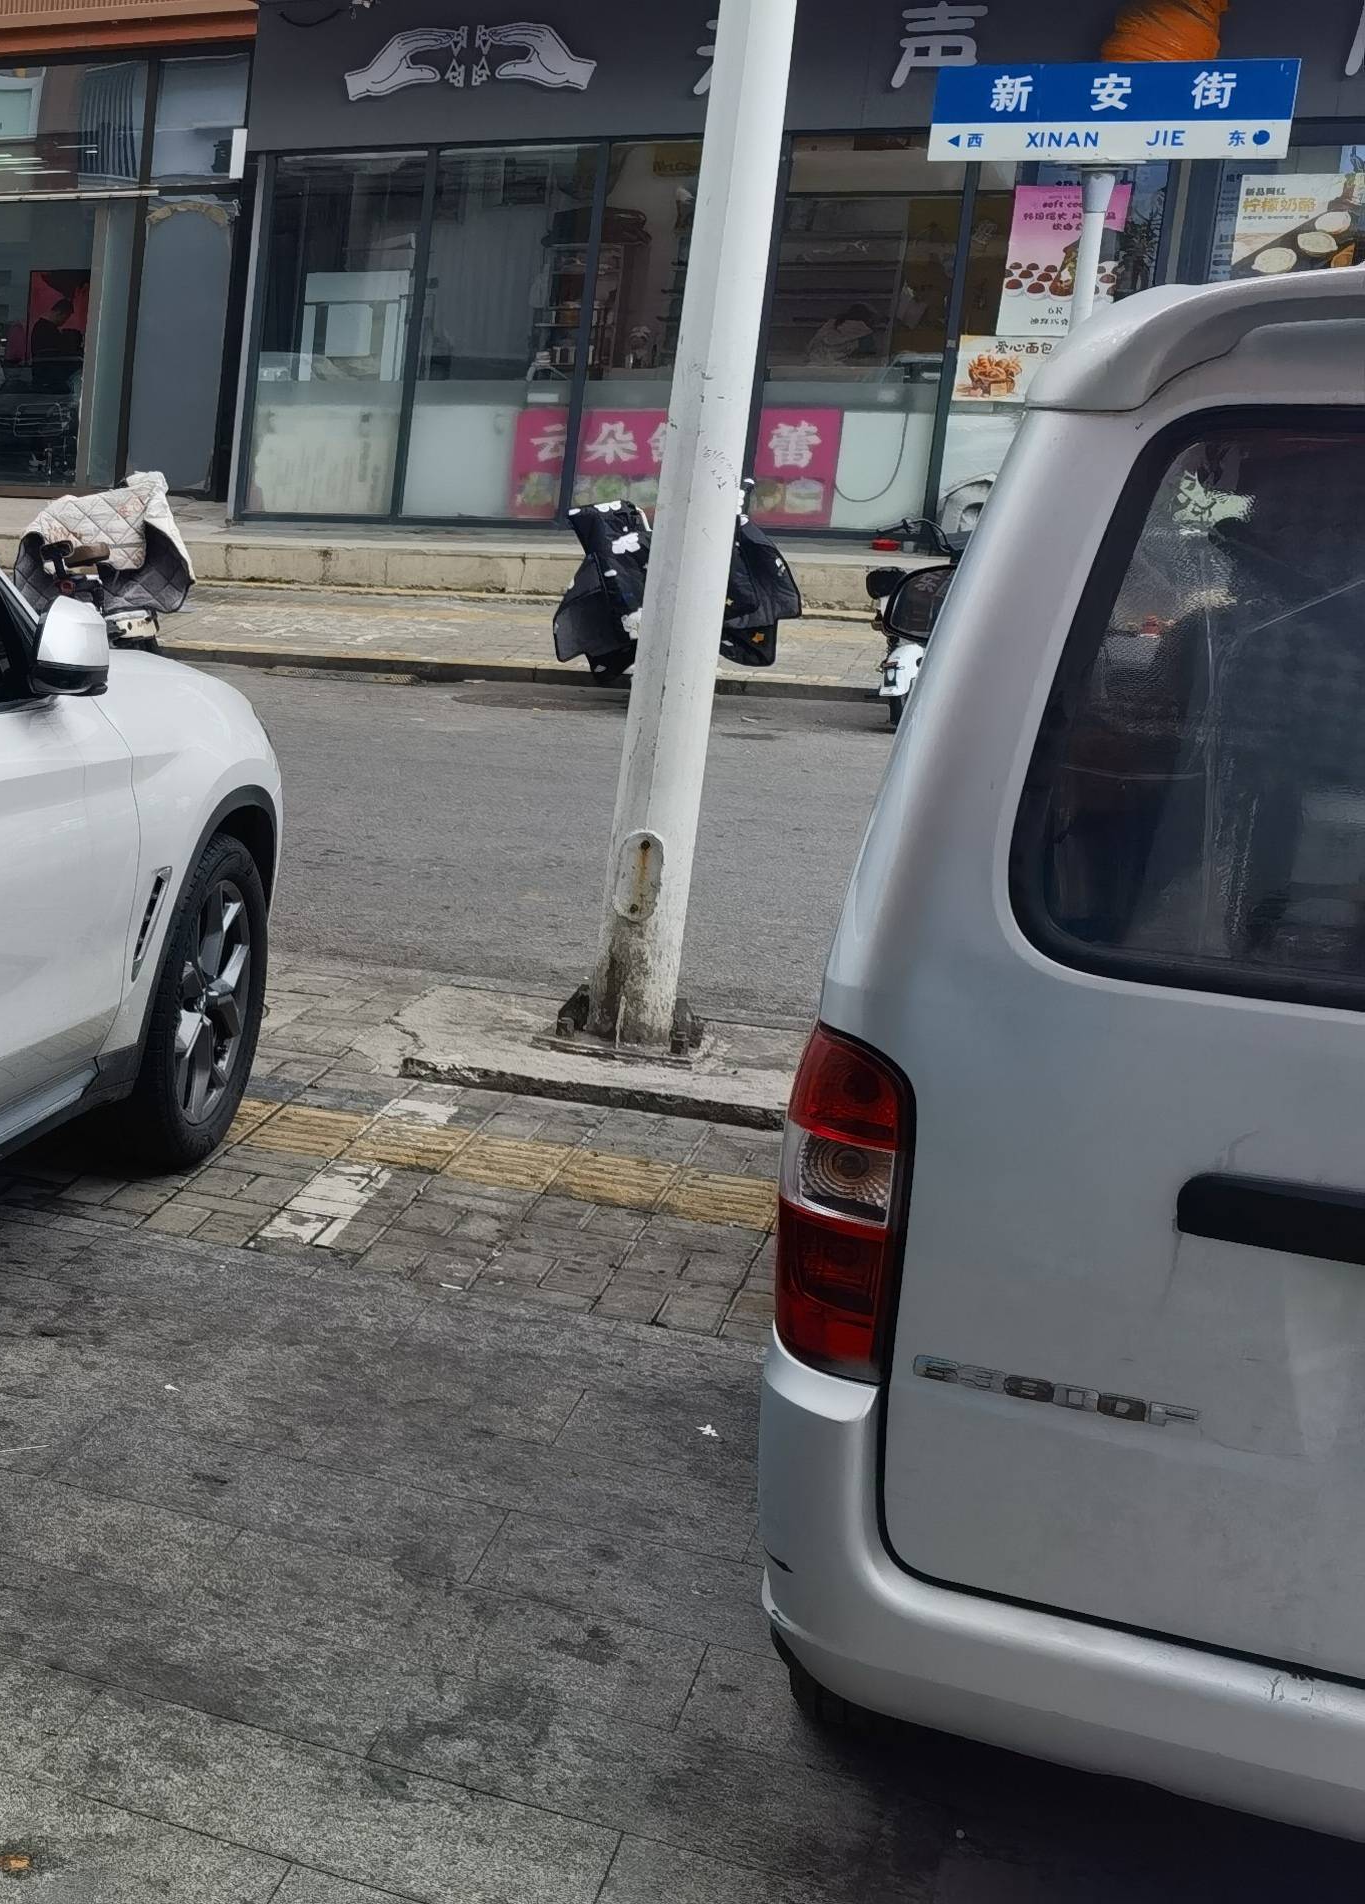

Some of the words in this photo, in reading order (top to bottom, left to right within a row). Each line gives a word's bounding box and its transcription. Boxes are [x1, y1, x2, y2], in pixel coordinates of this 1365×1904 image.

[990, 70, 1238, 113] 新安街
[966, 132, 984, 148] 西
[1025, 131, 1100, 149] XINAN
[1145, 129, 1186, 148] JIE
[1227, 130, 1247, 148] 东
[994, 340, 1053, 355] 爱心面包
[530, 420, 821, 468] 云朵蕾
